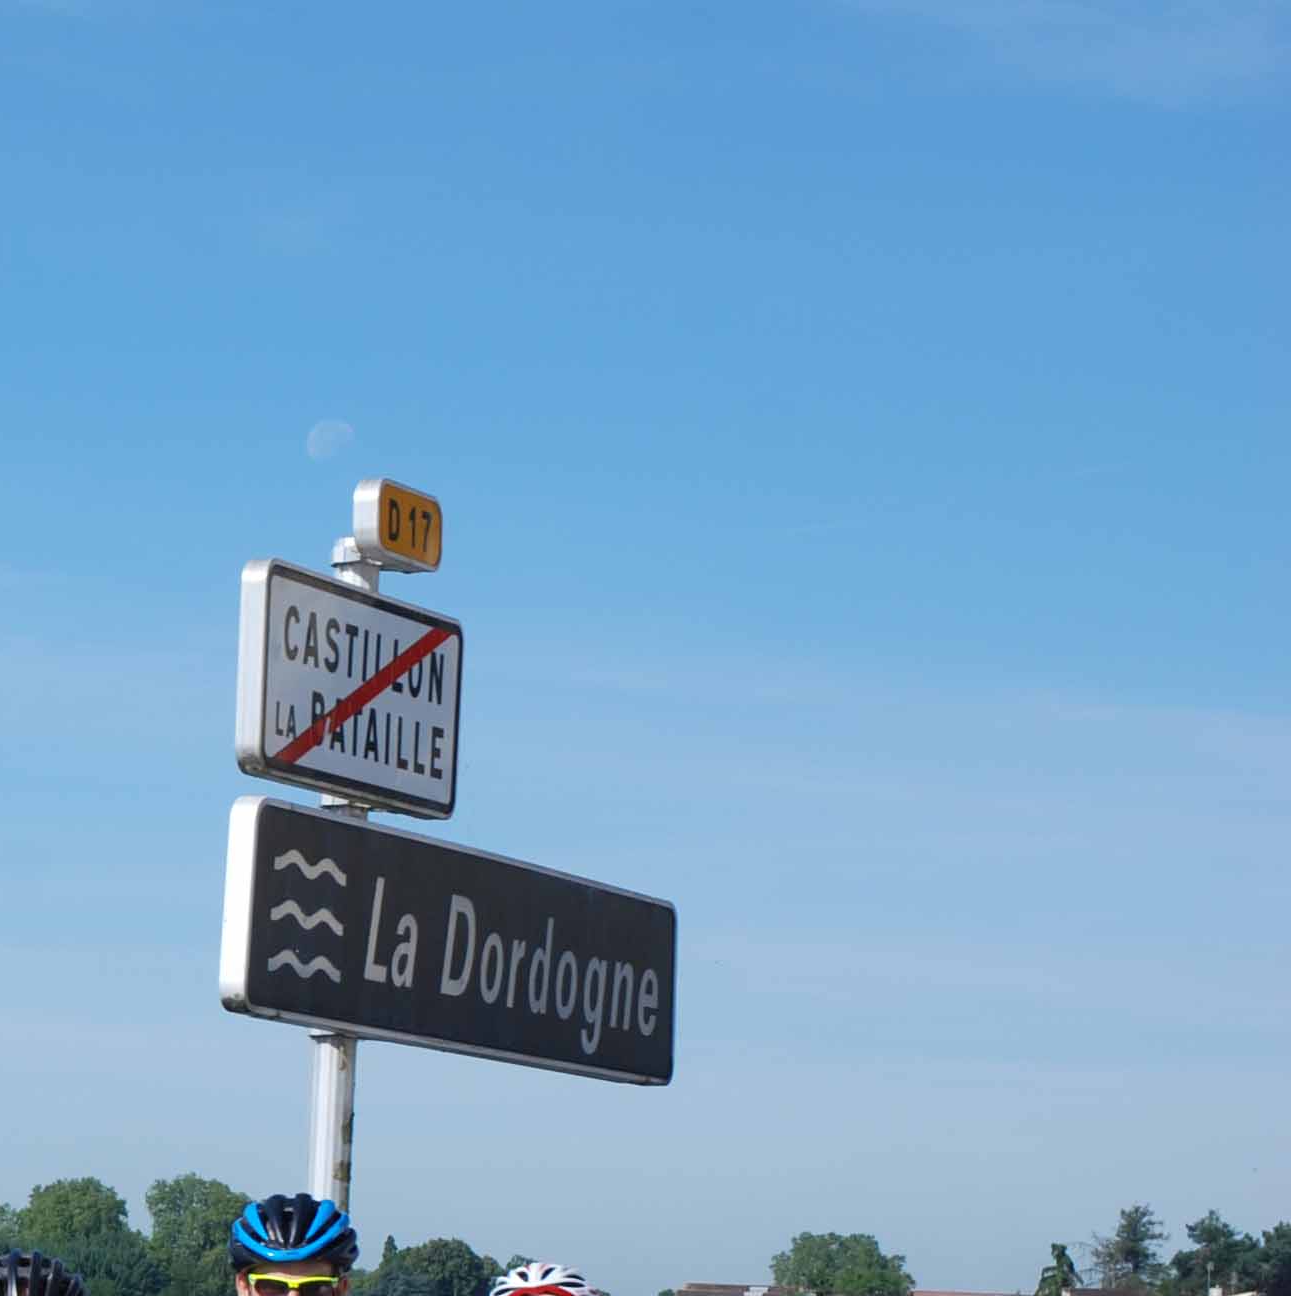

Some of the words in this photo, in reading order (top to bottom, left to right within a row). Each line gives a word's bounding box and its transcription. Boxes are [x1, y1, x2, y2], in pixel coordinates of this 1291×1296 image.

[388, 498, 400, 541] D
[409, 506, 433, 553] 17
[284, 605, 444, 705] CASTILLON
[275, 701, 297, 743] LA
[310, 690, 445, 780] BATAILLE
[363, 876, 418, 989] La
[440, 894, 660, 1056] Dordogne
